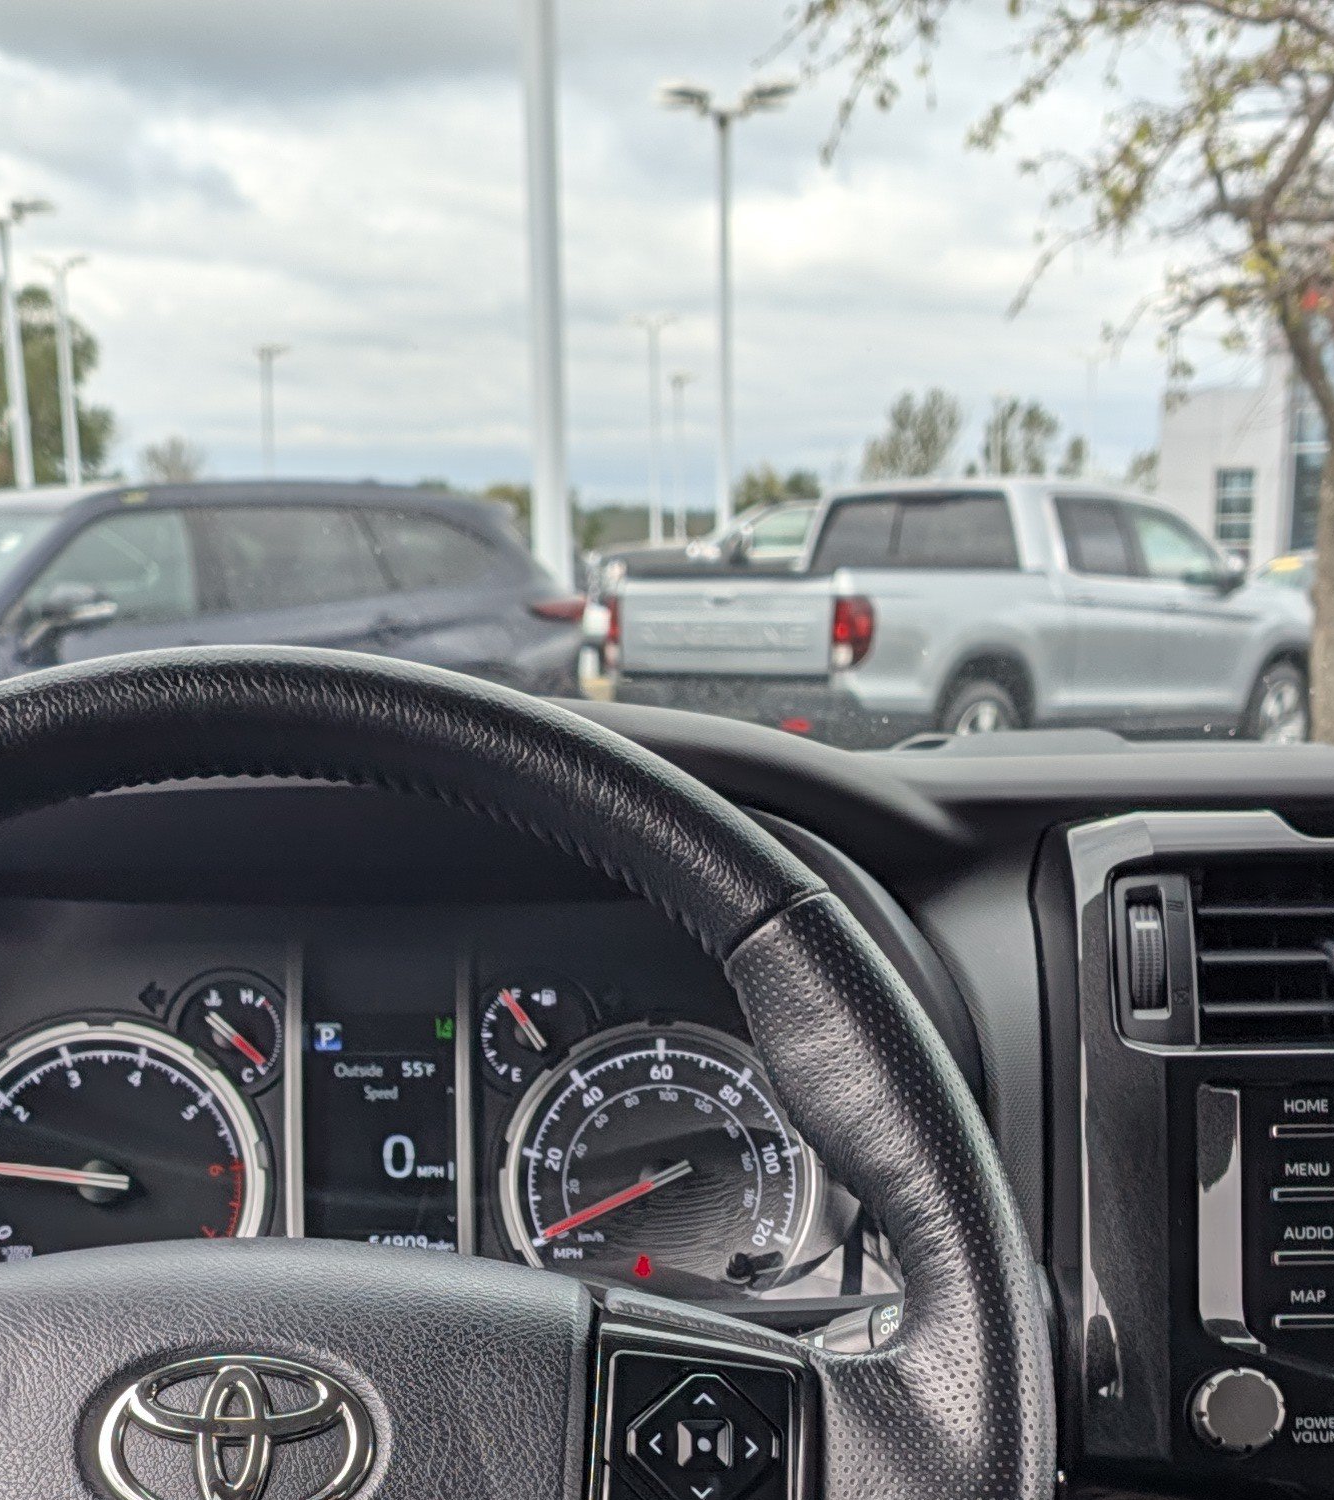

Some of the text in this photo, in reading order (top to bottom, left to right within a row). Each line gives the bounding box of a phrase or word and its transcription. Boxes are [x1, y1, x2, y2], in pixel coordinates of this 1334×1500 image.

[241, 1068, 254, 1083] C
[333, 1062, 383, 1078] Outside
[511, 1068, 522, 1082] E
[650, 1064, 673, 1080] 60
[67, 1070, 82, 1088] 3
[127, 1070, 142, 1087] 4
[364, 1085, 399, 1102] Speed
[582, 1086, 605, 1108] 40
[718, 1084, 743, 1107] 80
[14, 1105, 31, 1122] 2
[181, 1105, 199, 1121] 5
[1283, 1099, 1328, 1113] HOME
[383, 1135, 444, 1178] 0 MPH
[544, 1147, 563, 1172] 20
[761, 1142, 782, 1175] 100
[1285, 1163, 1330, 1177] MENU
[752, 1218, 776, 1248] 120
[1284, 1226, 1334, 1240] AUDIO
[553, 1248, 583, 1260] MPH
[1290, 1289, 1326, 1304] MAP
[881, 1320, 900, 1334] ON
